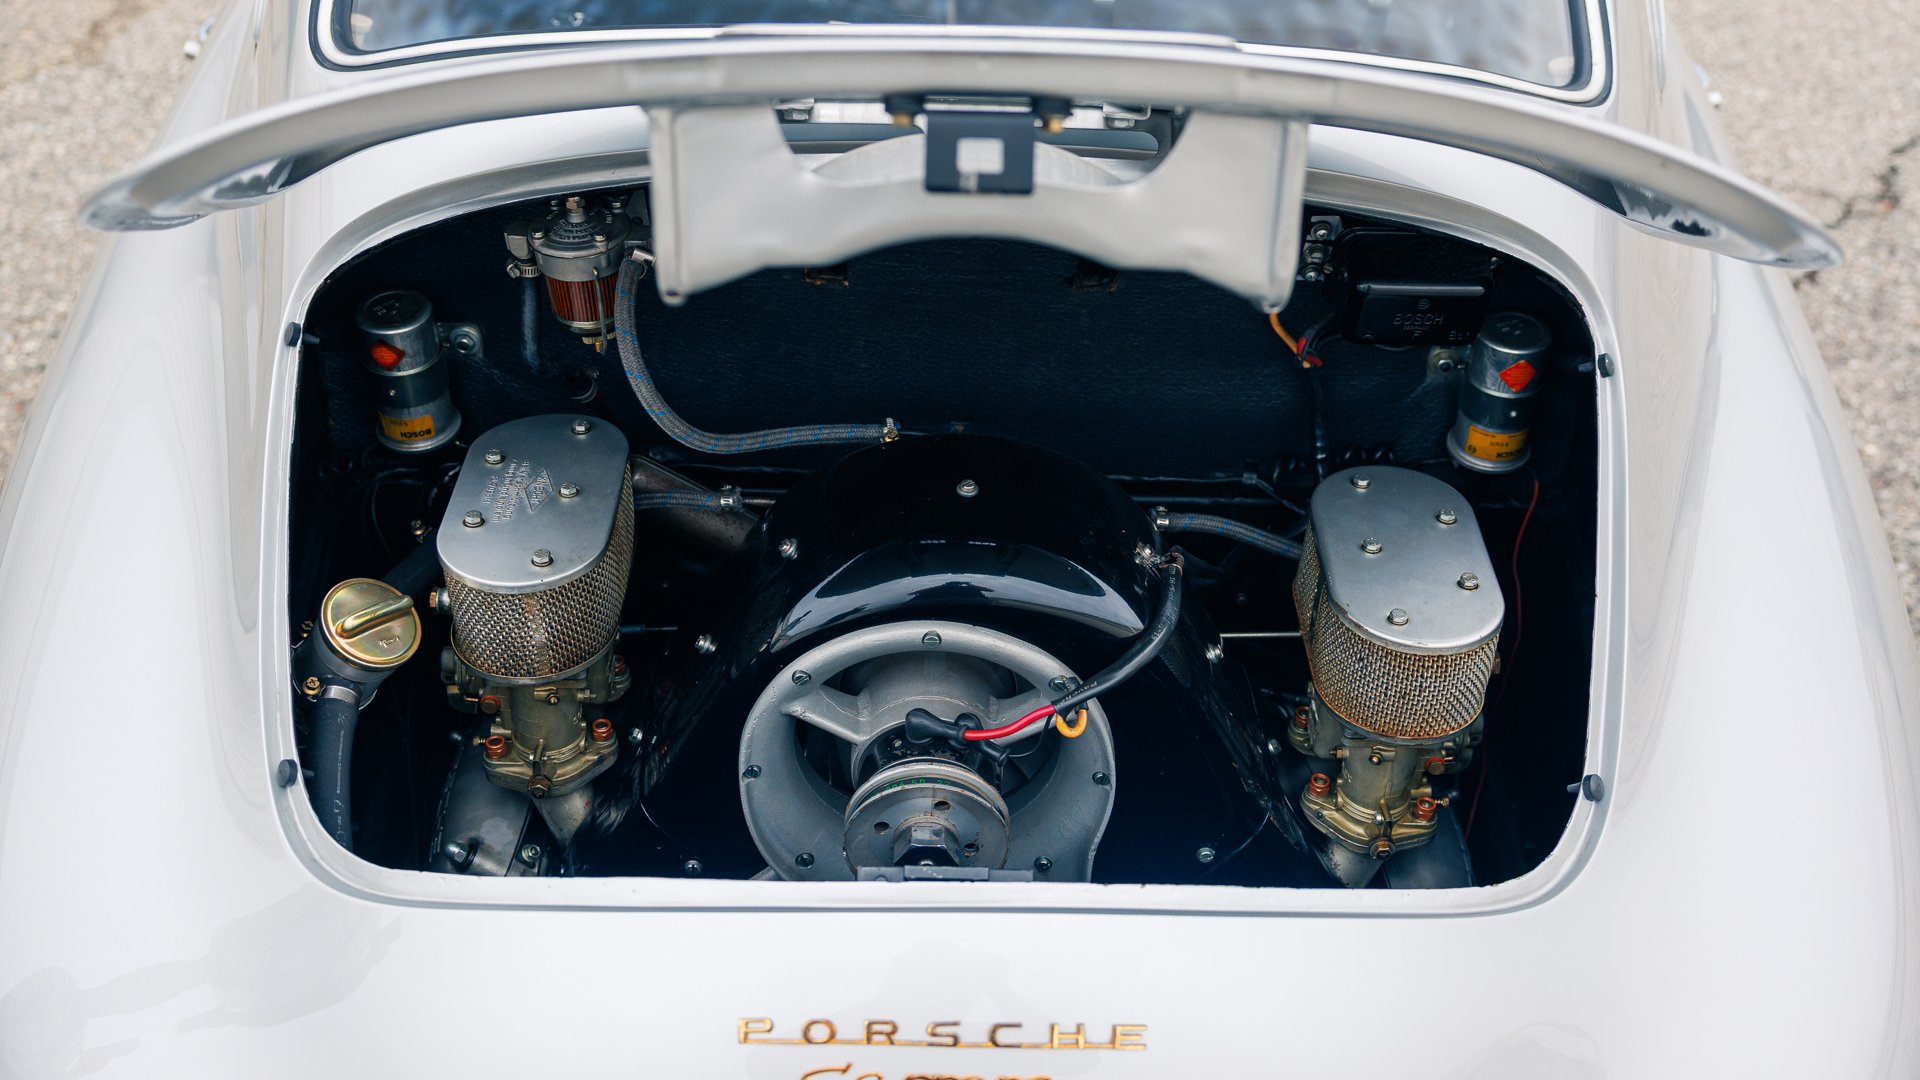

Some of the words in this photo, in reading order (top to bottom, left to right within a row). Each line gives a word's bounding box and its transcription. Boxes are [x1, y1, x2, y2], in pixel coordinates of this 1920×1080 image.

[1393, 314, 1445, 325] BOSCH
[400, 427, 433, 440] BOSCH
[738, 1017, 1147, 1050] PORSCHE
